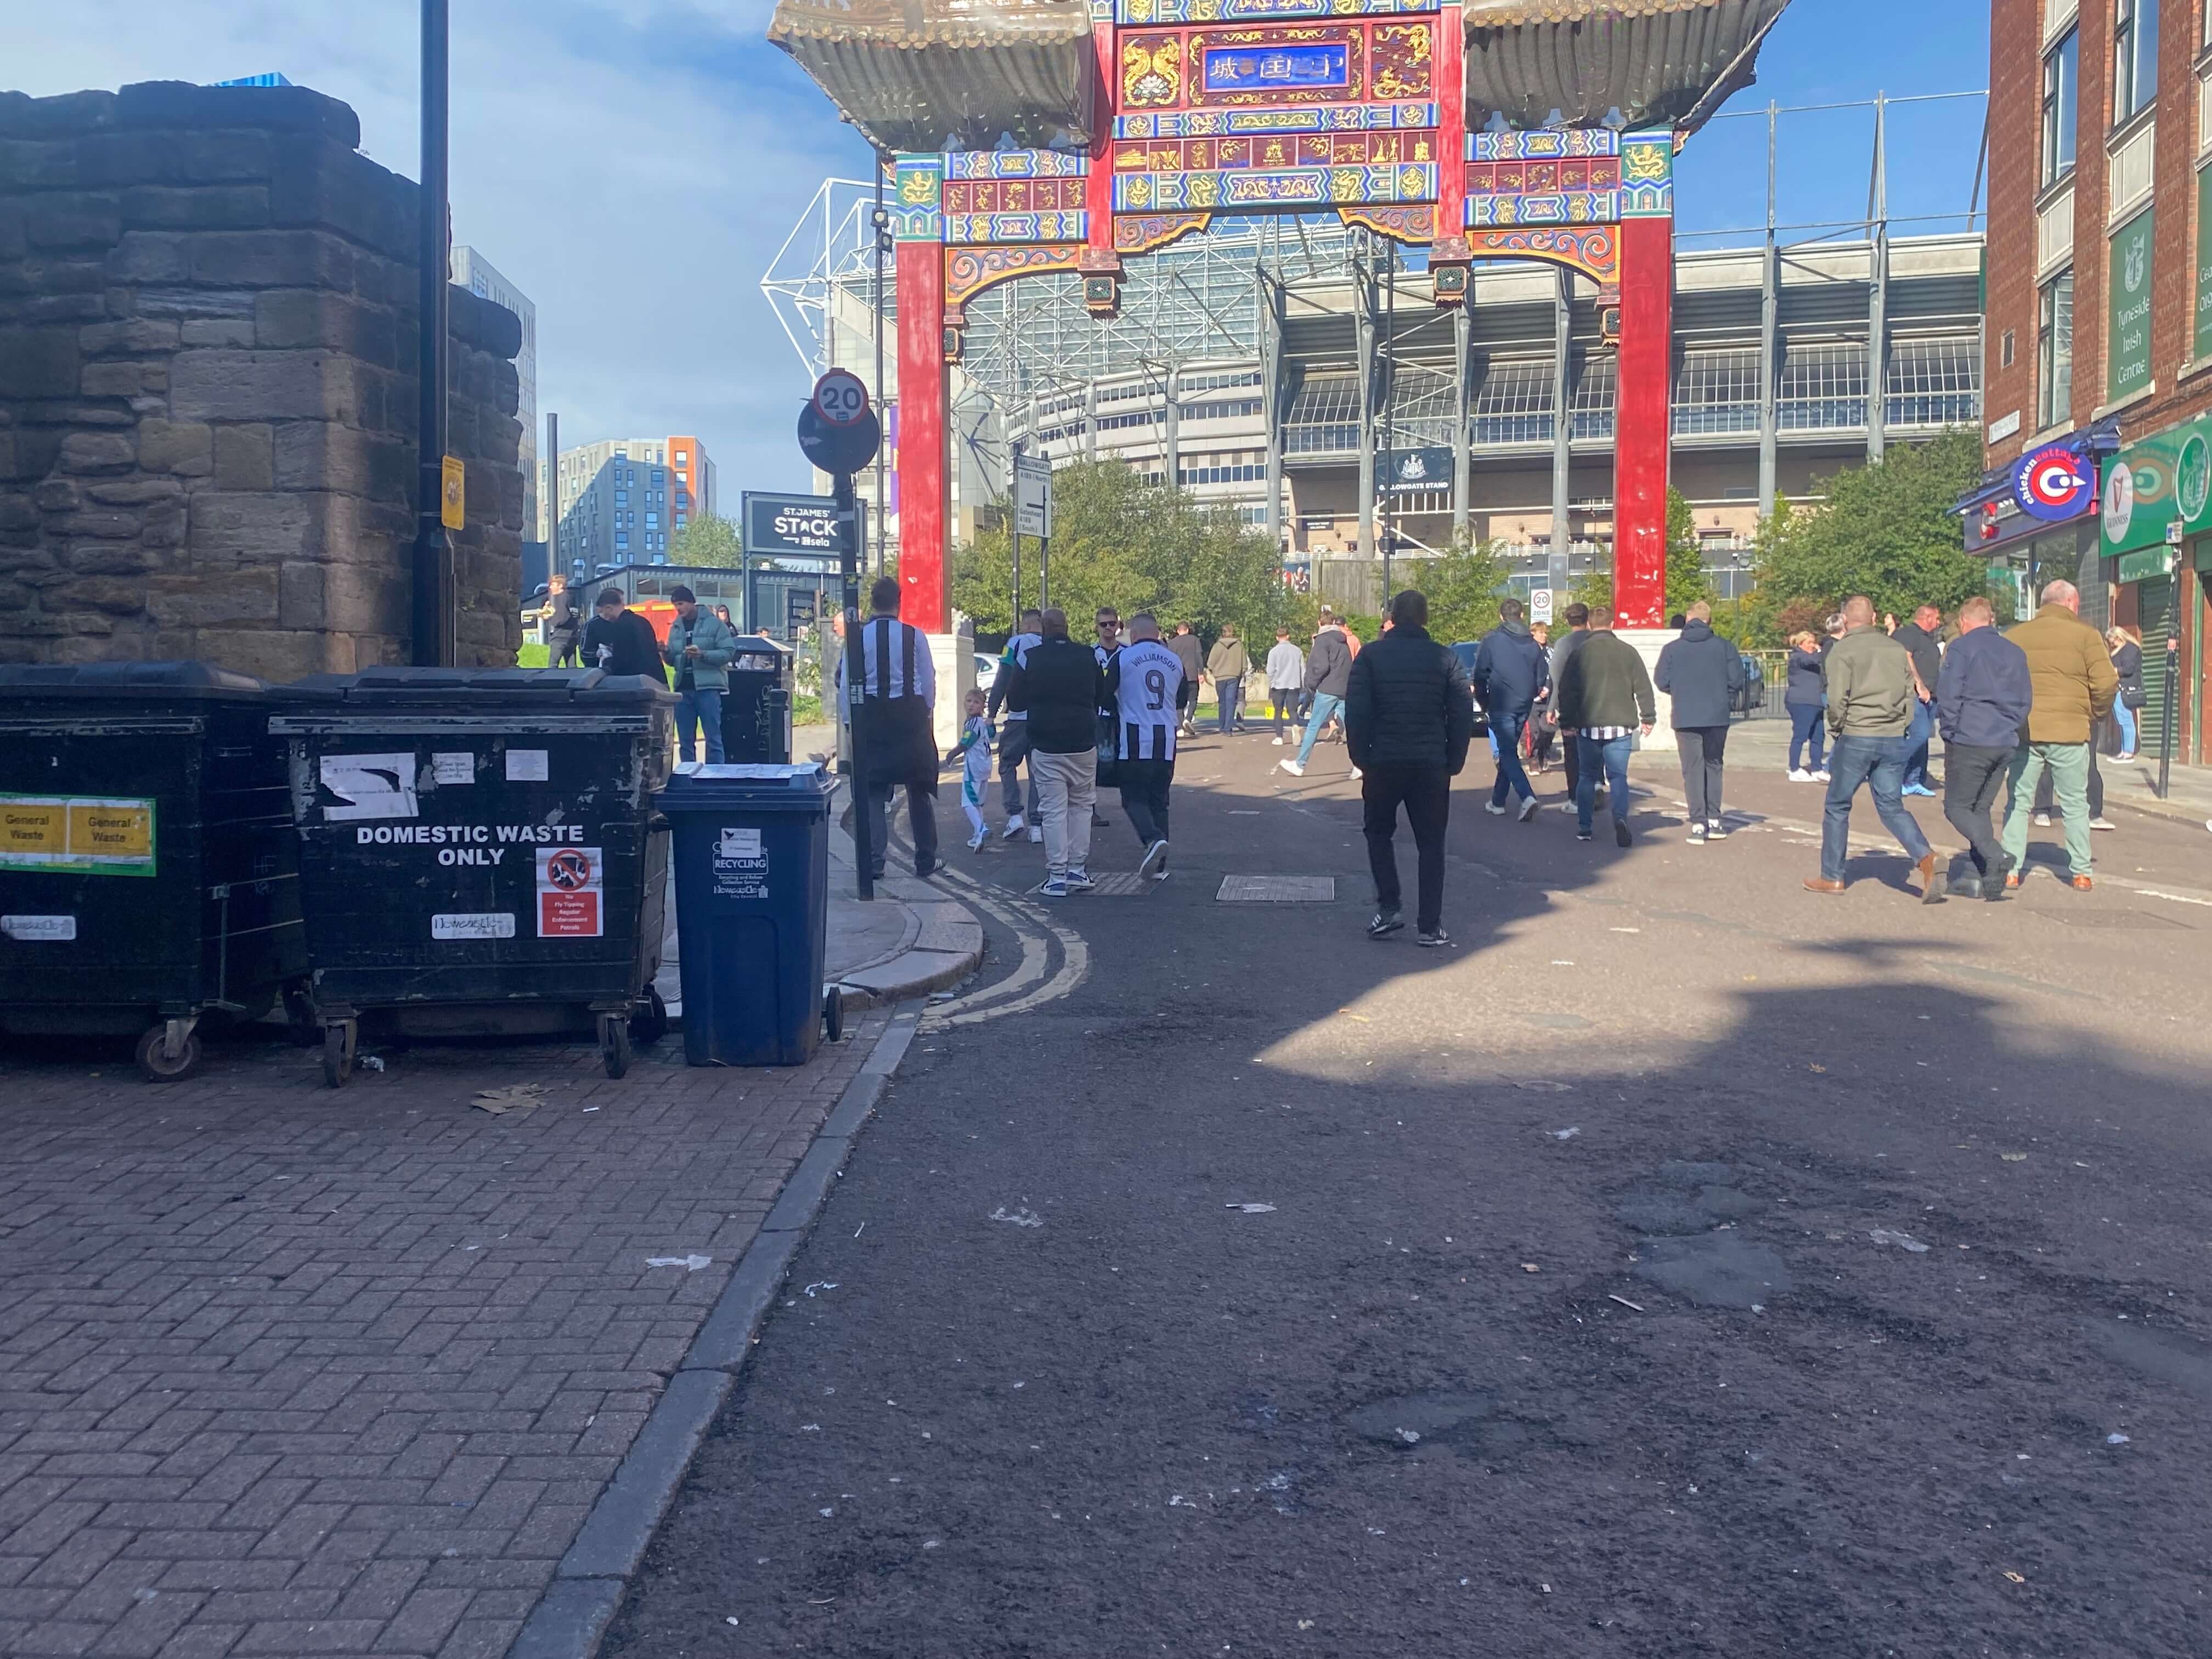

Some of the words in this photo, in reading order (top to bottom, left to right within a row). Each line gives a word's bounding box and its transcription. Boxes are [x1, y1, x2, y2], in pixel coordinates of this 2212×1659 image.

[2118, 296, 2149, 331] Tyneside
[2123, 329, 2141, 354] Irish
[2118, 359, 2146, 384] Centre
[823, 387, 861, 410] 20
[1019, 459, 1050, 471] GALLOWGATE
[1019, 507, 1042, 517] Gateshead
[774, 516, 839, 536] STACK
[2106, 514, 2129, 529] GUINNESS
[1019, 523, 1037, 533] (South)
[810, 537, 830, 546] sela
[1536, 596, 1548, 604] 20
[1132, 653, 1176, 672] WILLIAMSON
[1146, 669, 1165, 710] 9
[5, 815, 49, 826] General
[88, 817, 131, 828] General
[10, 830, 44, 840] Waste
[92, 832, 126, 843] Waste
[357, 826, 488, 844] DOMESTIC
[496, 825, 583, 842] WASTE
[438, 849, 505, 866] ONLY
[715, 859, 766, 868] RECYCLING
[713, 885, 758, 894] Newcastle
